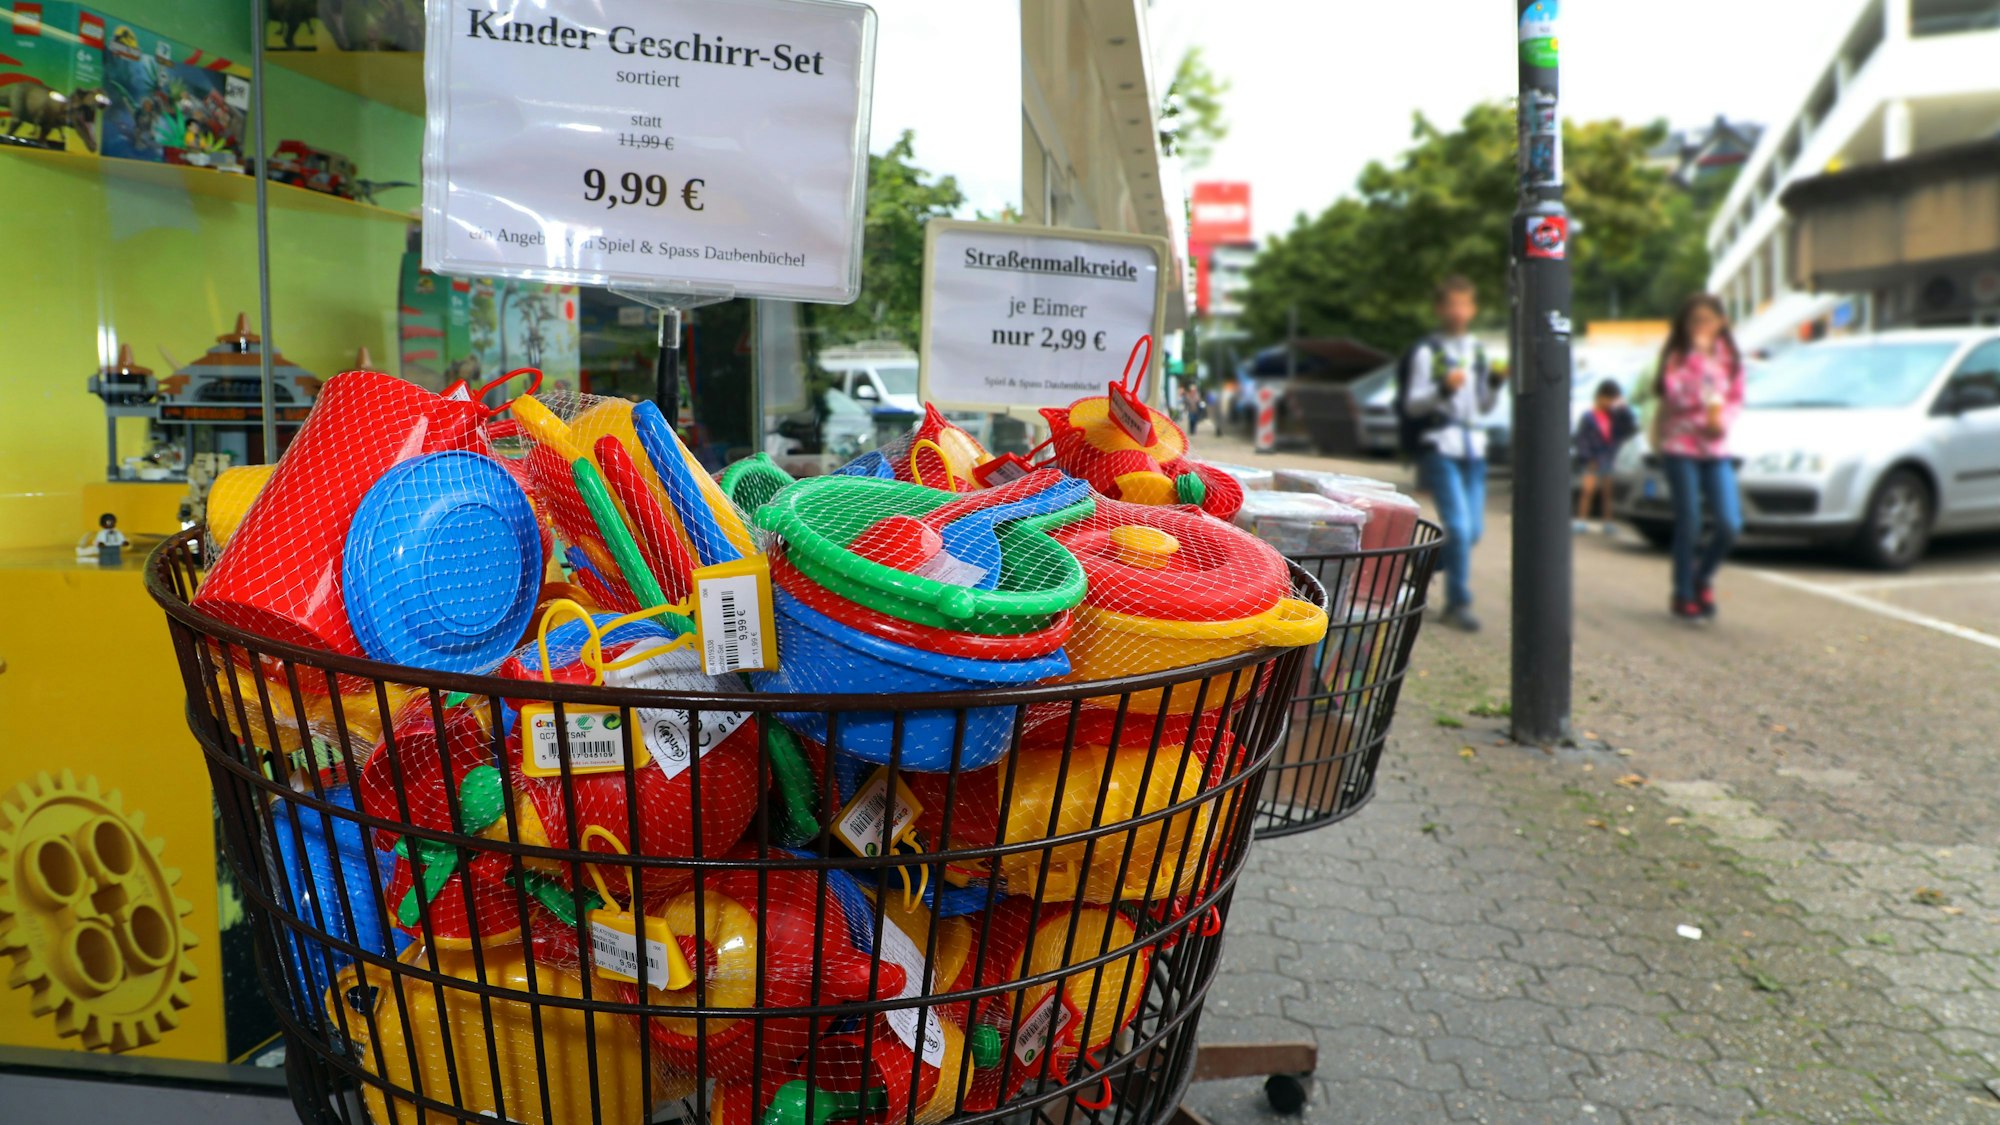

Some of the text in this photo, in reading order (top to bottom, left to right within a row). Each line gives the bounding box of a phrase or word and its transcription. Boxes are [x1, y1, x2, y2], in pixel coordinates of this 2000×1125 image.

[467, 7, 825, 75] Kinder Geschirr-Set
[616, 67, 681, 88] sortiert
[630, 113, 662, 129] statt
[618, 132, 675, 151] 11,99 €
[583, 168, 705, 211] 9,99 €
[497, 228, 547, 247] Angeb
[598, 237, 635, 254] Spiel
[640, 241, 653, 255] &
[658, 241, 700, 261] Spass
[704, 244, 806, 268] Daubenbüchel
[964, 247, 1138, 281] Straßenmalkreide
[1008, 297, 1087, 318] je Eimer
[991, 327, 1106, 353] nur 2,99 €
[737, 609, 749, 641] 9,99 €
[751, 637, 759, 656] 11,99
